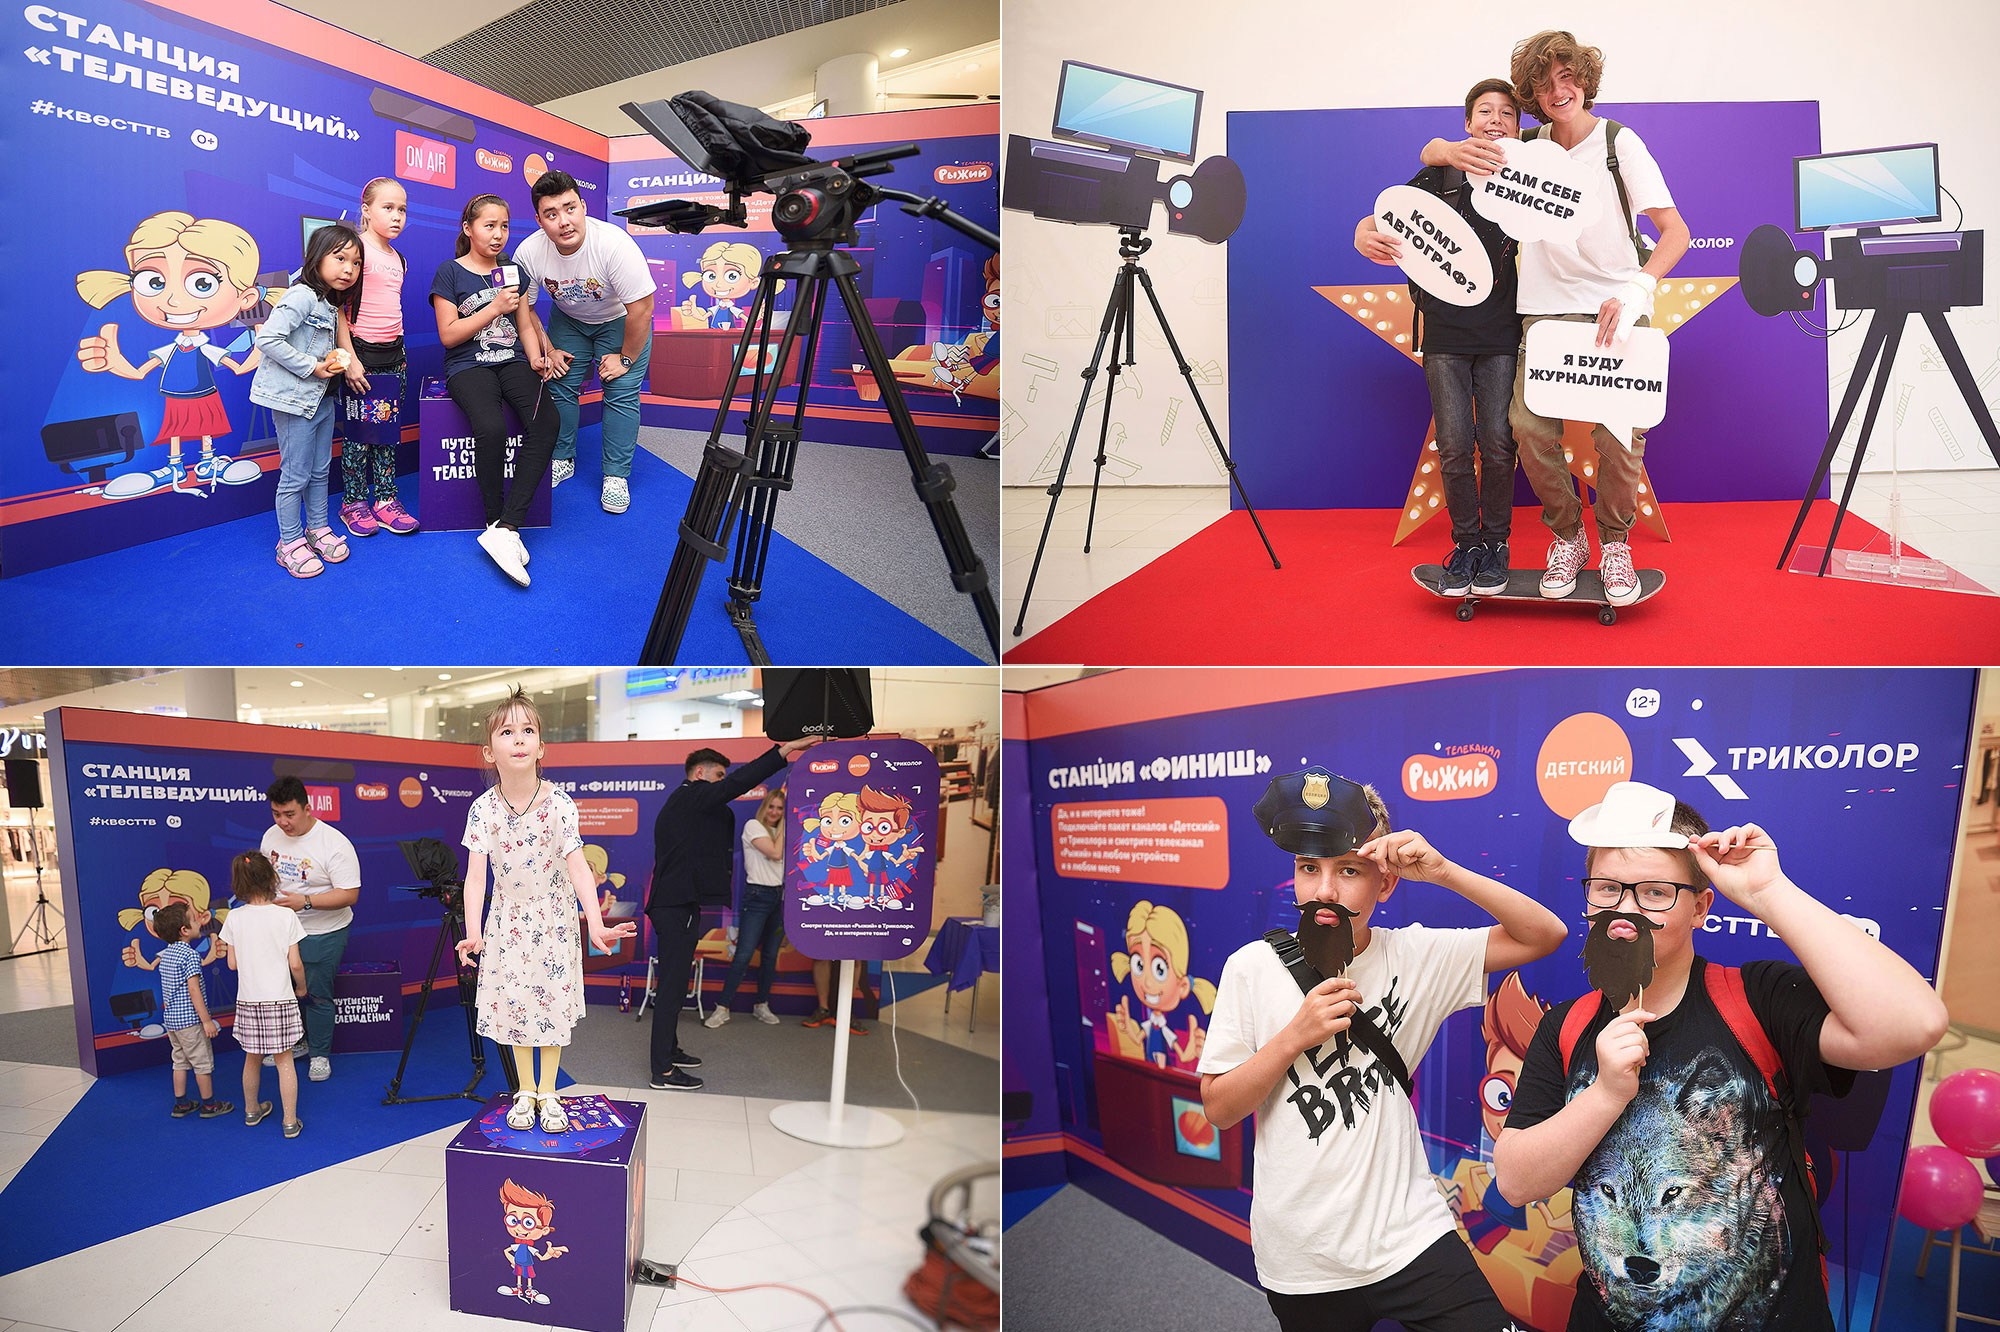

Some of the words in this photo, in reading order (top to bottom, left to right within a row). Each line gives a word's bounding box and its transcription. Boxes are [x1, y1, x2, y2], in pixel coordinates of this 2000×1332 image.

[24, 4, 240, 84] СТАНЦИЯ
[24, 46, 361, 142] «ТЕЛЕВЕДУЩИЙ»
[406, 145, 425, 170] ON
[427, 150, 447, 175] AIR
[1500, 166, 1538, 189] САМ
[1541, 179, 1582, 204] СЕБЕ
[1484, 181, 1575, 220] РЕЖИССЕР
[1409, 209, 1462, 255] КОМУ
[1381, 210, 1477, 294] АВТОГРАФ?
[1688, 237, 1734, 249] КОЛОР
[1563, 354, 1573, 366] Я
[1578, 355, 1624, 371] БУДУ
[1529, 368, 1662, 393] ЖУРНАЛИСТОМ
[1631, 695, 1657, 709] 12+
[1445, 743, 1501, 759] ТЕЛЕКАНАЛ
[1728, 743, 1920, 771] ТРИКОЛОР
[82, 763, 191, 781] СТАНЦИЯ
[1048, 760, 1136, 789] СТАНЦИЯ
[1139, 749, 1273, 783] «ФИНИШ»
[1544, 756, 1625, 780] ДЕТСКИЙ
[84, 785, 267, 804] «ТЕЛЕВЕДУЩИЙ»
[441, 789, 473, 797] ТРИКОЛОР
[579, 780, 666, 792] «ФИНИШ»
[316, 794, 333, 811] AIR
[335, 1012, 391, 1024] ЕЛЕВИДЕНИЯ
[344, 1004, 379, 1015] СТРАНУ
